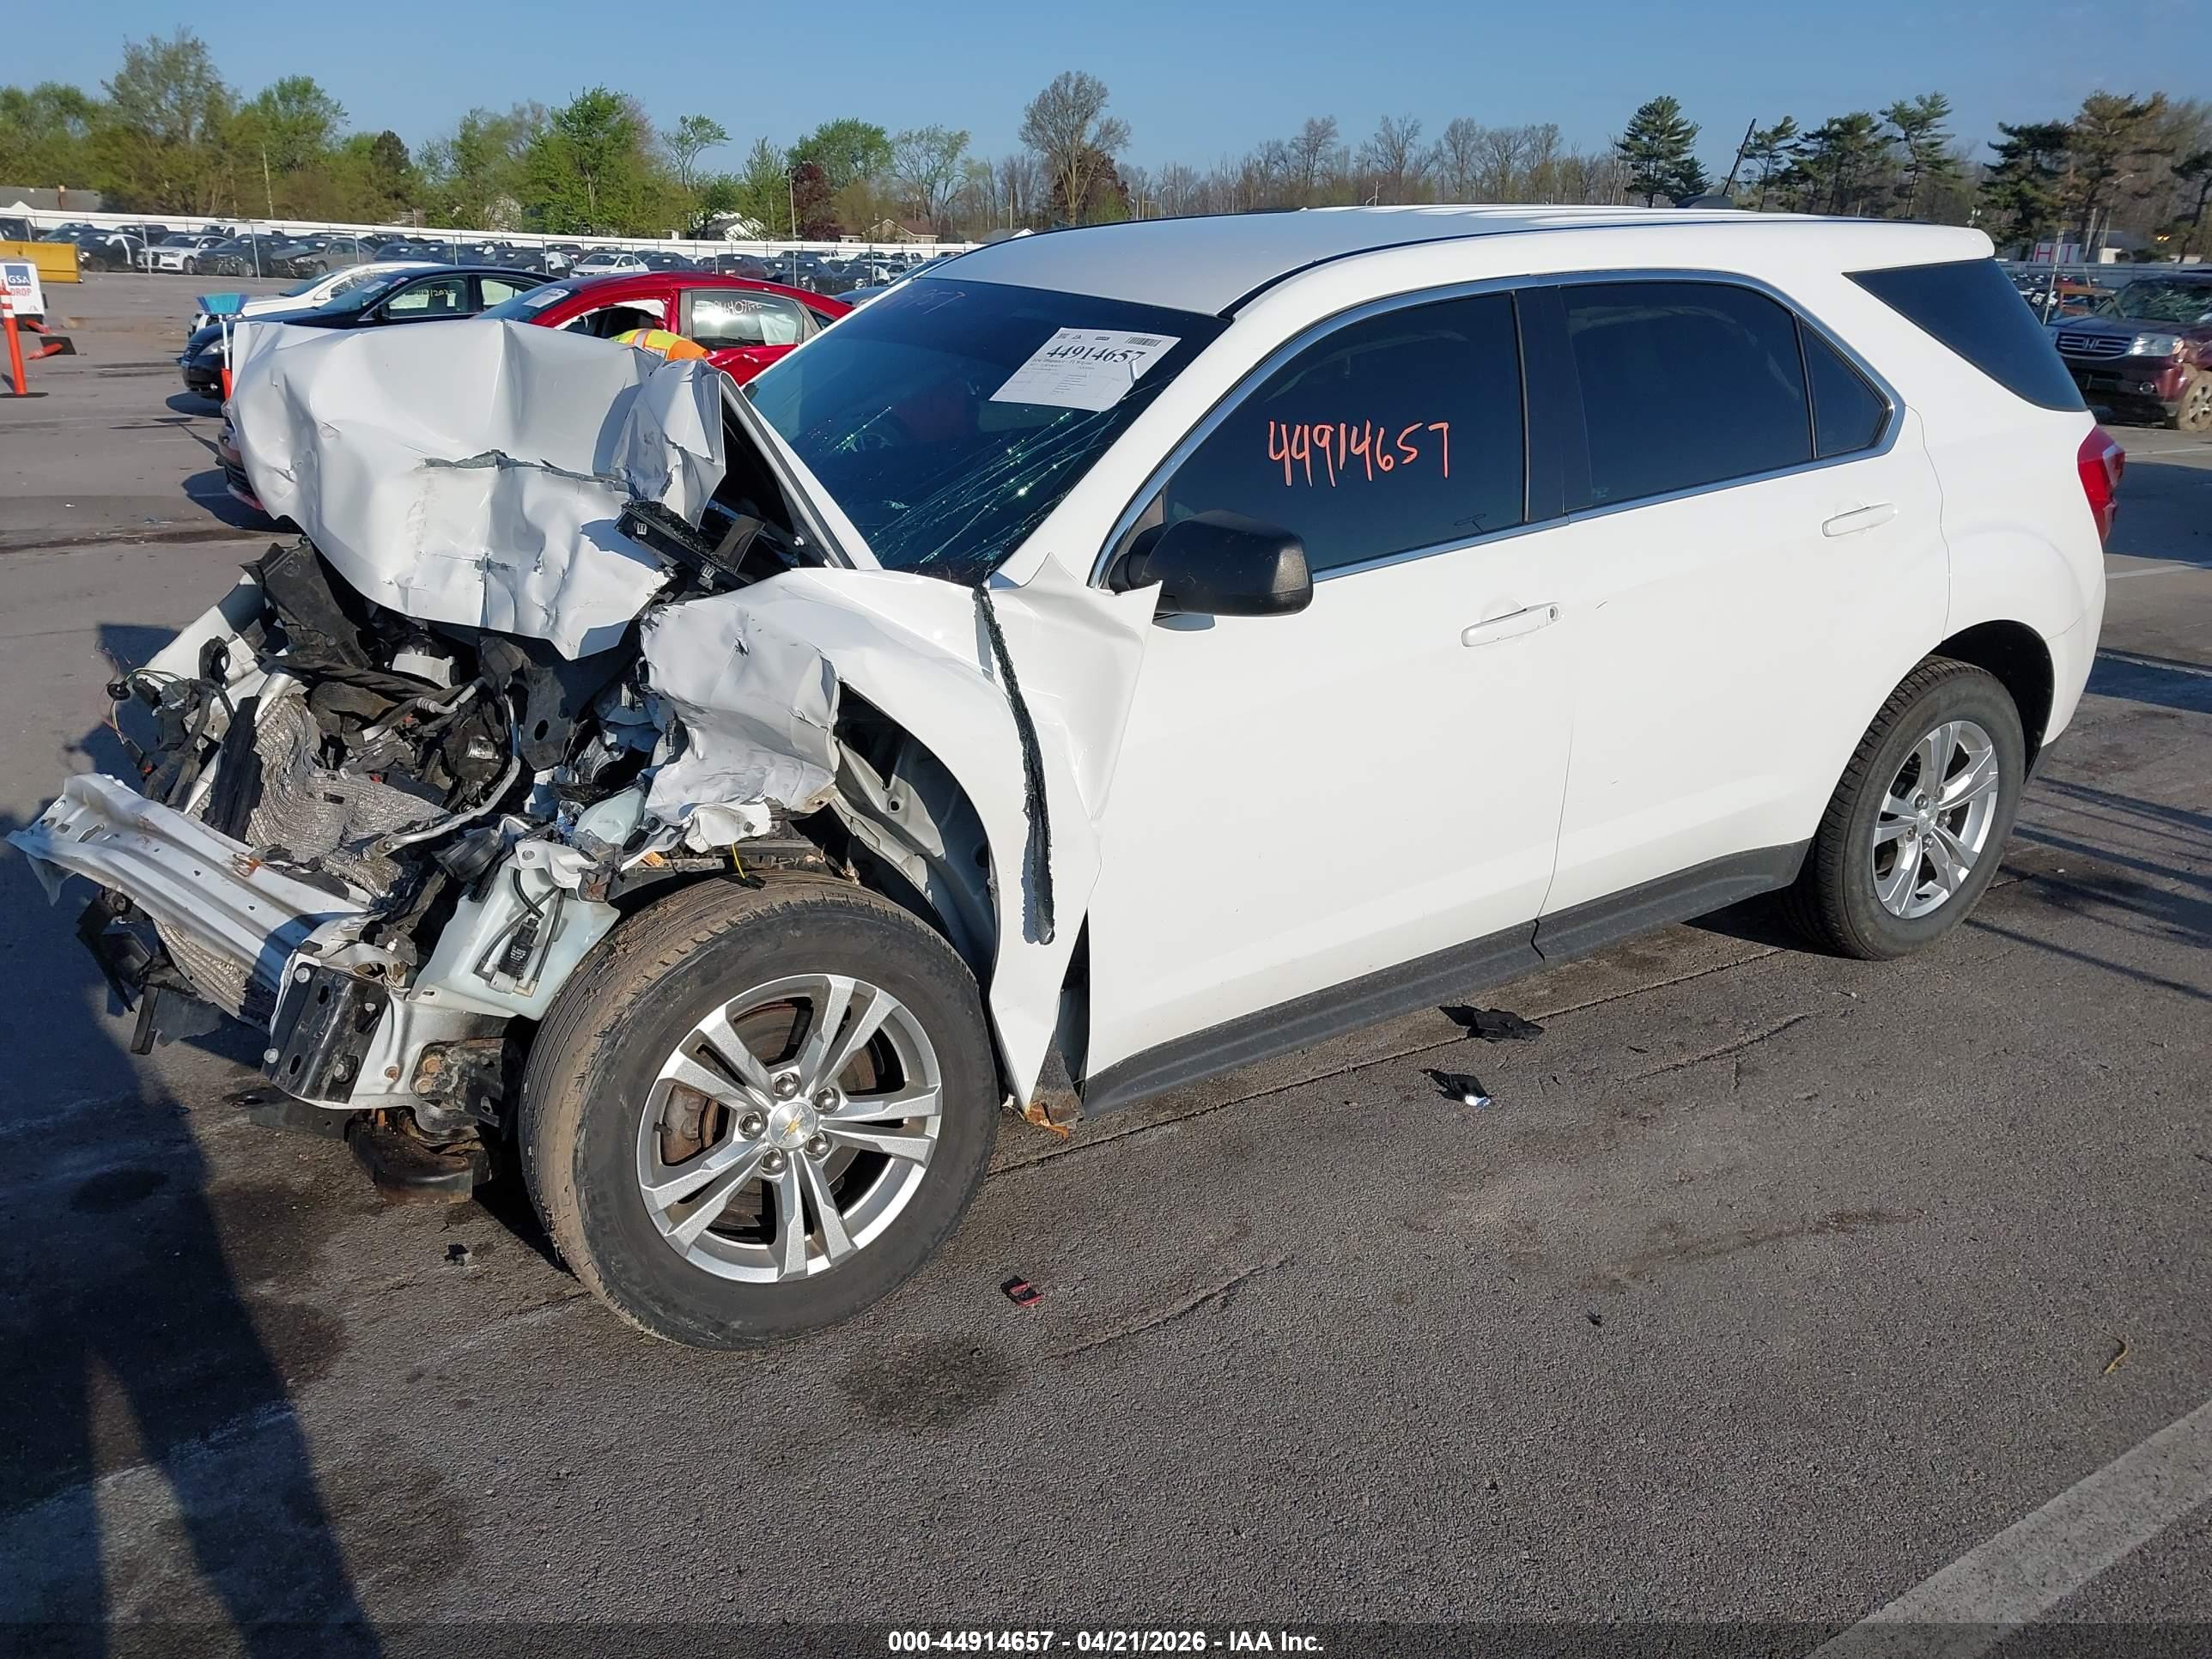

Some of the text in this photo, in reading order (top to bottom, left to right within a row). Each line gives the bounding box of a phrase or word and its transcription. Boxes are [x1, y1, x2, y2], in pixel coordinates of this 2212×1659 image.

[8, 275, 30, 283] GSA
[1046, 345, 1146, 365] 44914657
[1268, 419, 1449, 488] 44914657
